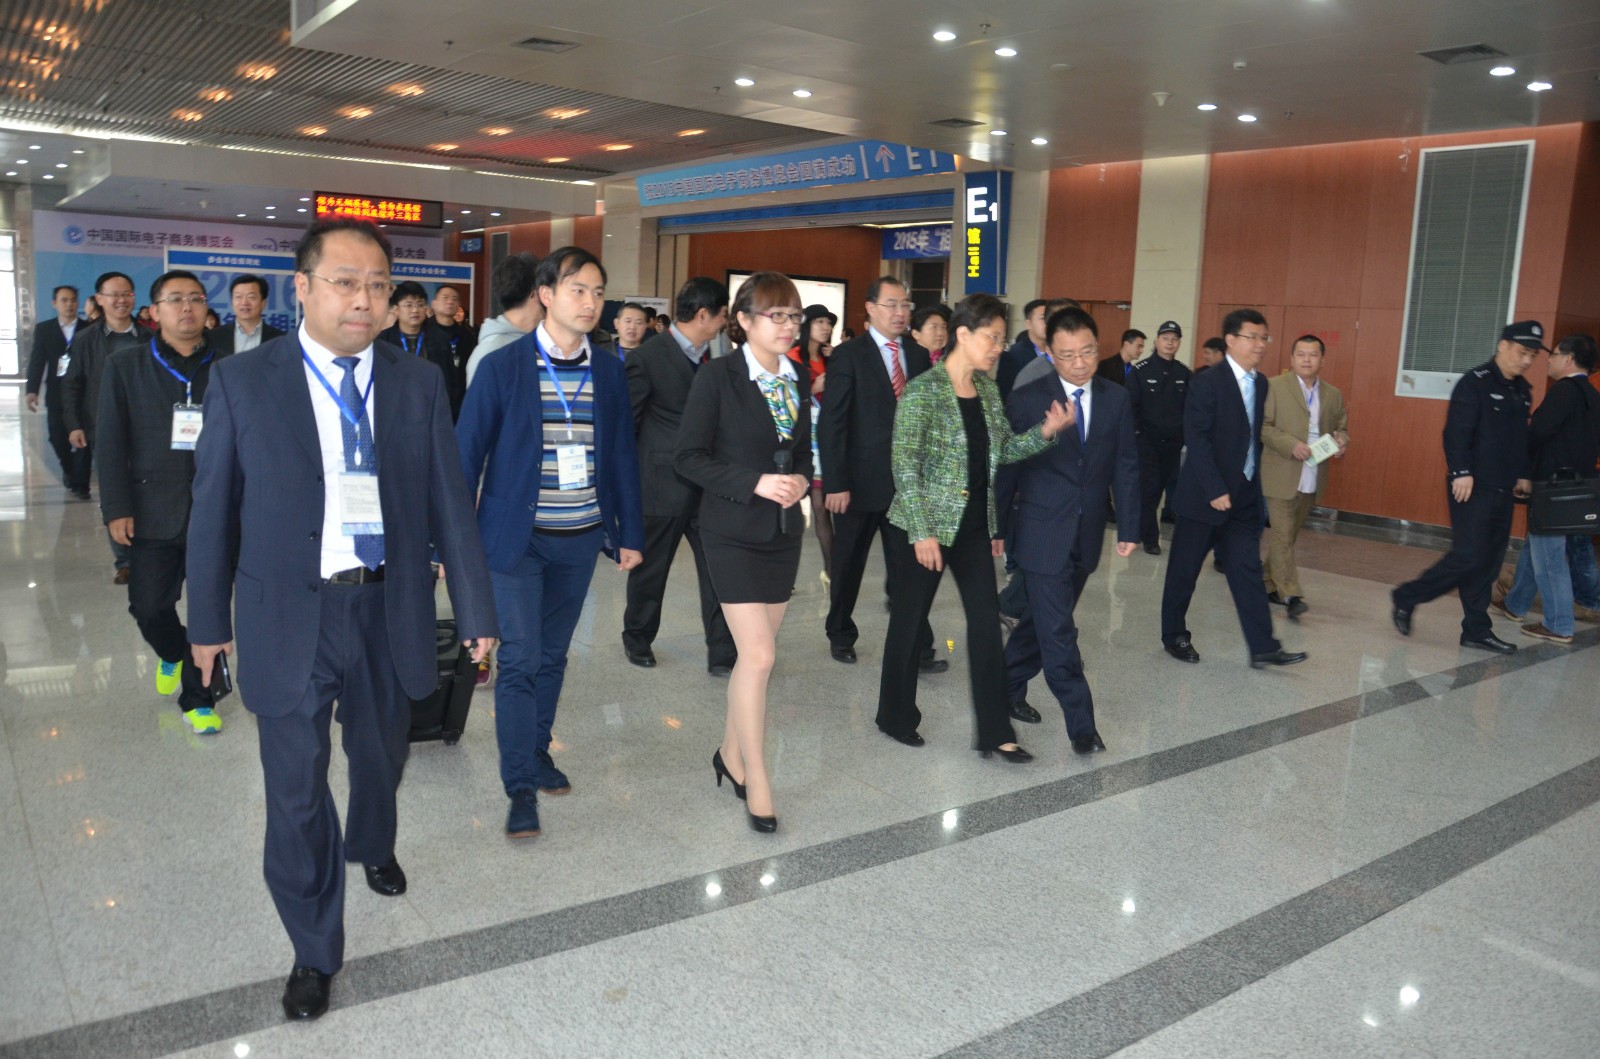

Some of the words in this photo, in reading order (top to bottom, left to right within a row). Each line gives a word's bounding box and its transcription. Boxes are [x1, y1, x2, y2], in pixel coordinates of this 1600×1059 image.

[967, 186, 998, 223] E1
[87, 228, 235, 248] 中国国际电子商务博览会
[967, 246, 980, 278] Hall
